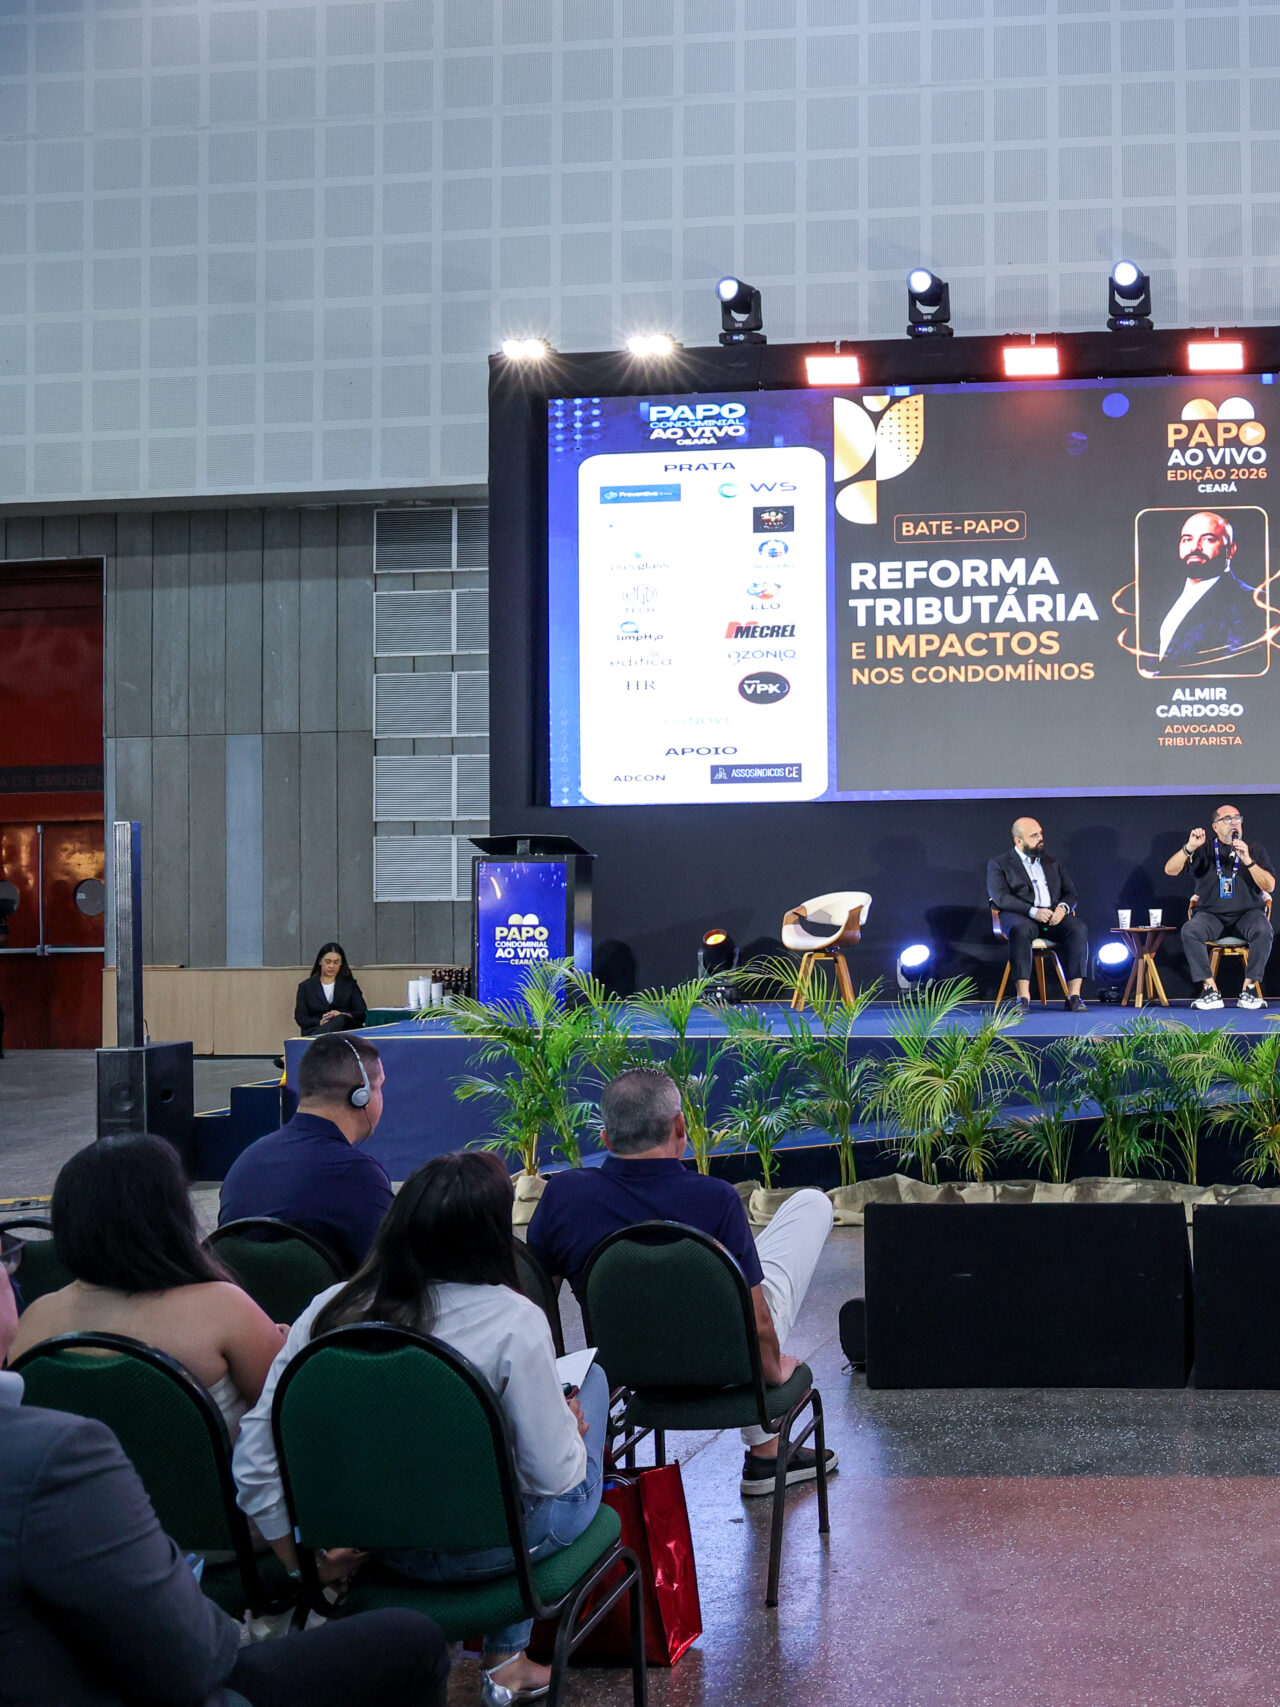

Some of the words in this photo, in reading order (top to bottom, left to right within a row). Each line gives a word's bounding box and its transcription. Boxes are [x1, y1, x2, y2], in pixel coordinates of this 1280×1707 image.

[650, 403, 746, 421] PAPO
[650, 428, 680, 440] AO
[687, 426, 746, 438] VIVO
[1167, 421, 1266, 448] PAPO
[1167, 448, 1204, 466] AO
[1207, 447, 1267, 465] VIVO
[664, 462, 736, 472] PRATA
[1167, 467, 1226, 483] EDIÇÃO
[1230, 468, 1267, 479] 2026
[1198, 481, 1237, 493] CEARÁ
[901, 518, 1020, 536] BATE-PAPO
[850, 557, 1060, 590] REFORMA
[848, 586, 1100, 627] TRIBUTÁRIA
[734, 624, 796, 639] MECREL
[851, 641, 866, 660] E
[875, 630, 1061, 659] IMPACTOS
[851, 667, 905, 685] NOS
[911, 659, 1095, 684] CONDOMÍNIOS
[1172, 688, 1227, 701] ALMIR
[1156, 704, 1244, 718] CARDOSO
[1164, 723, 1236, 734] ADVOGADO
[1158, 736, 1243, 746] TRIBUTARISTA
[665, 746, 738, 756] APOIO
[613, 774, 666, 782] ADCON
[731, 767, 784, 778] ASSOSÍNDICOS
[785, 766, 800, 778] CE
[495, 926, 549, 941] PAPO
[495, 948, 515, 958] AO
[517, 948, 549, 958] VIVO
